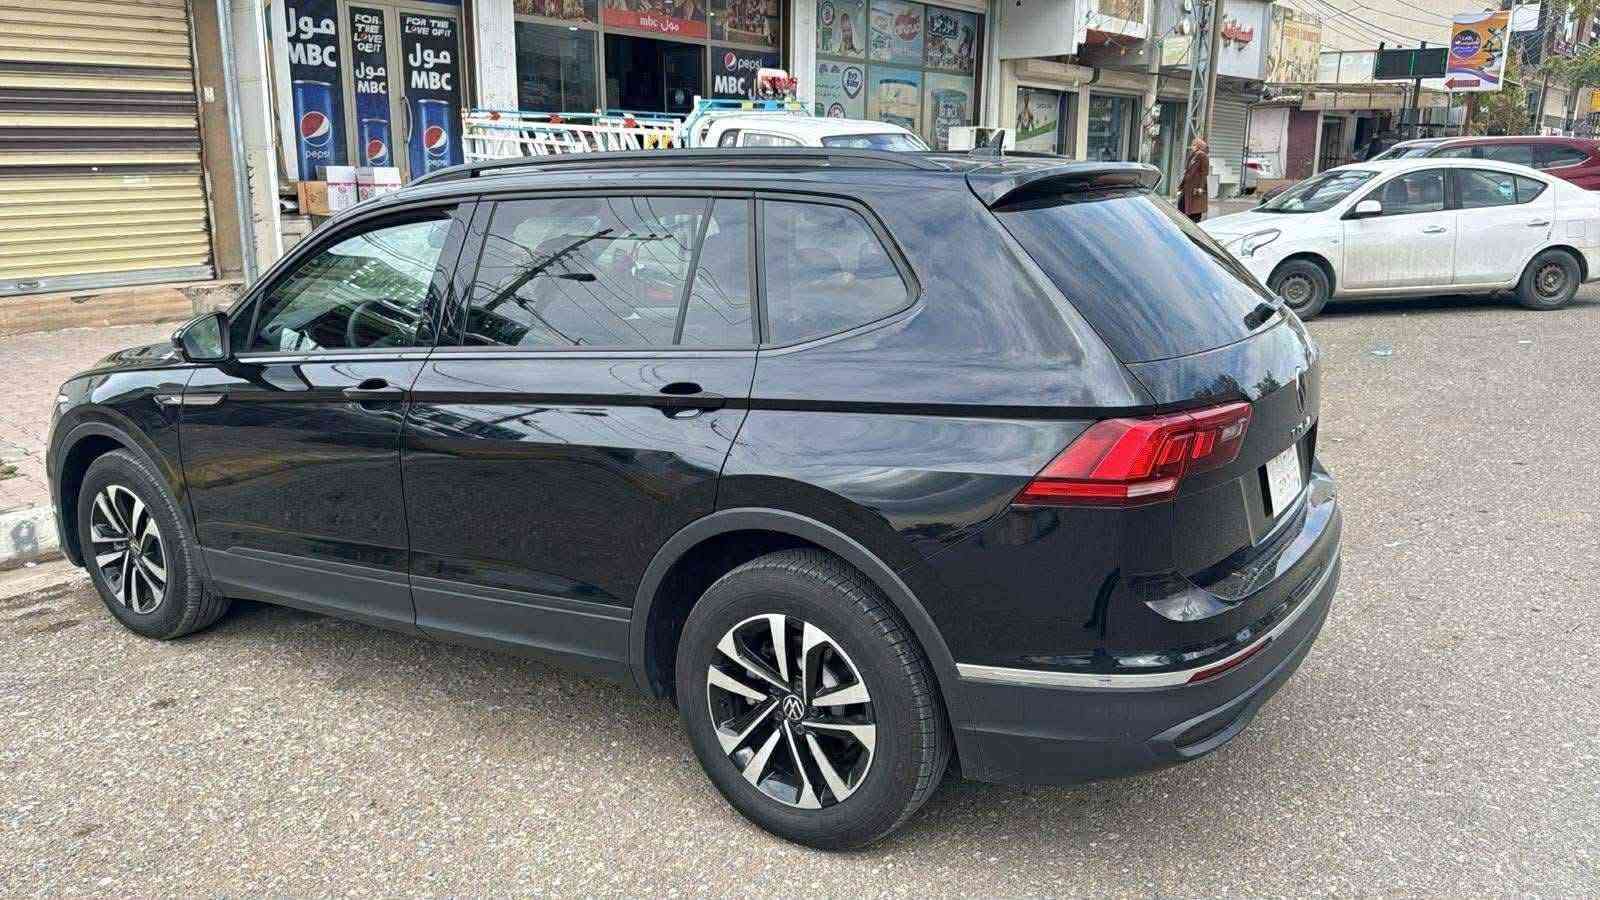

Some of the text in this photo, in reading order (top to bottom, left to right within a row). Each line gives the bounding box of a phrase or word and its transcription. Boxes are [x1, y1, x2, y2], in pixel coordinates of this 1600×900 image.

[287, 7, 335, 40] مول
[354, 14, 380, 24] FOR
[406, 17, 427, 26] FOR
[353, 32, 384, 43] LOVE
[405, 25, 430, 36] LOVE
[287, 41, 337, 67] MBC
[408, 42, 451, 69] مول
[355, 61, 386, 79] مول
[738, 58, 763, 71] pepsi
[357, 81, 387, 94] MBC
[411, 70, 452, 91] MBC
[714, 74, 745, 95] MBC
